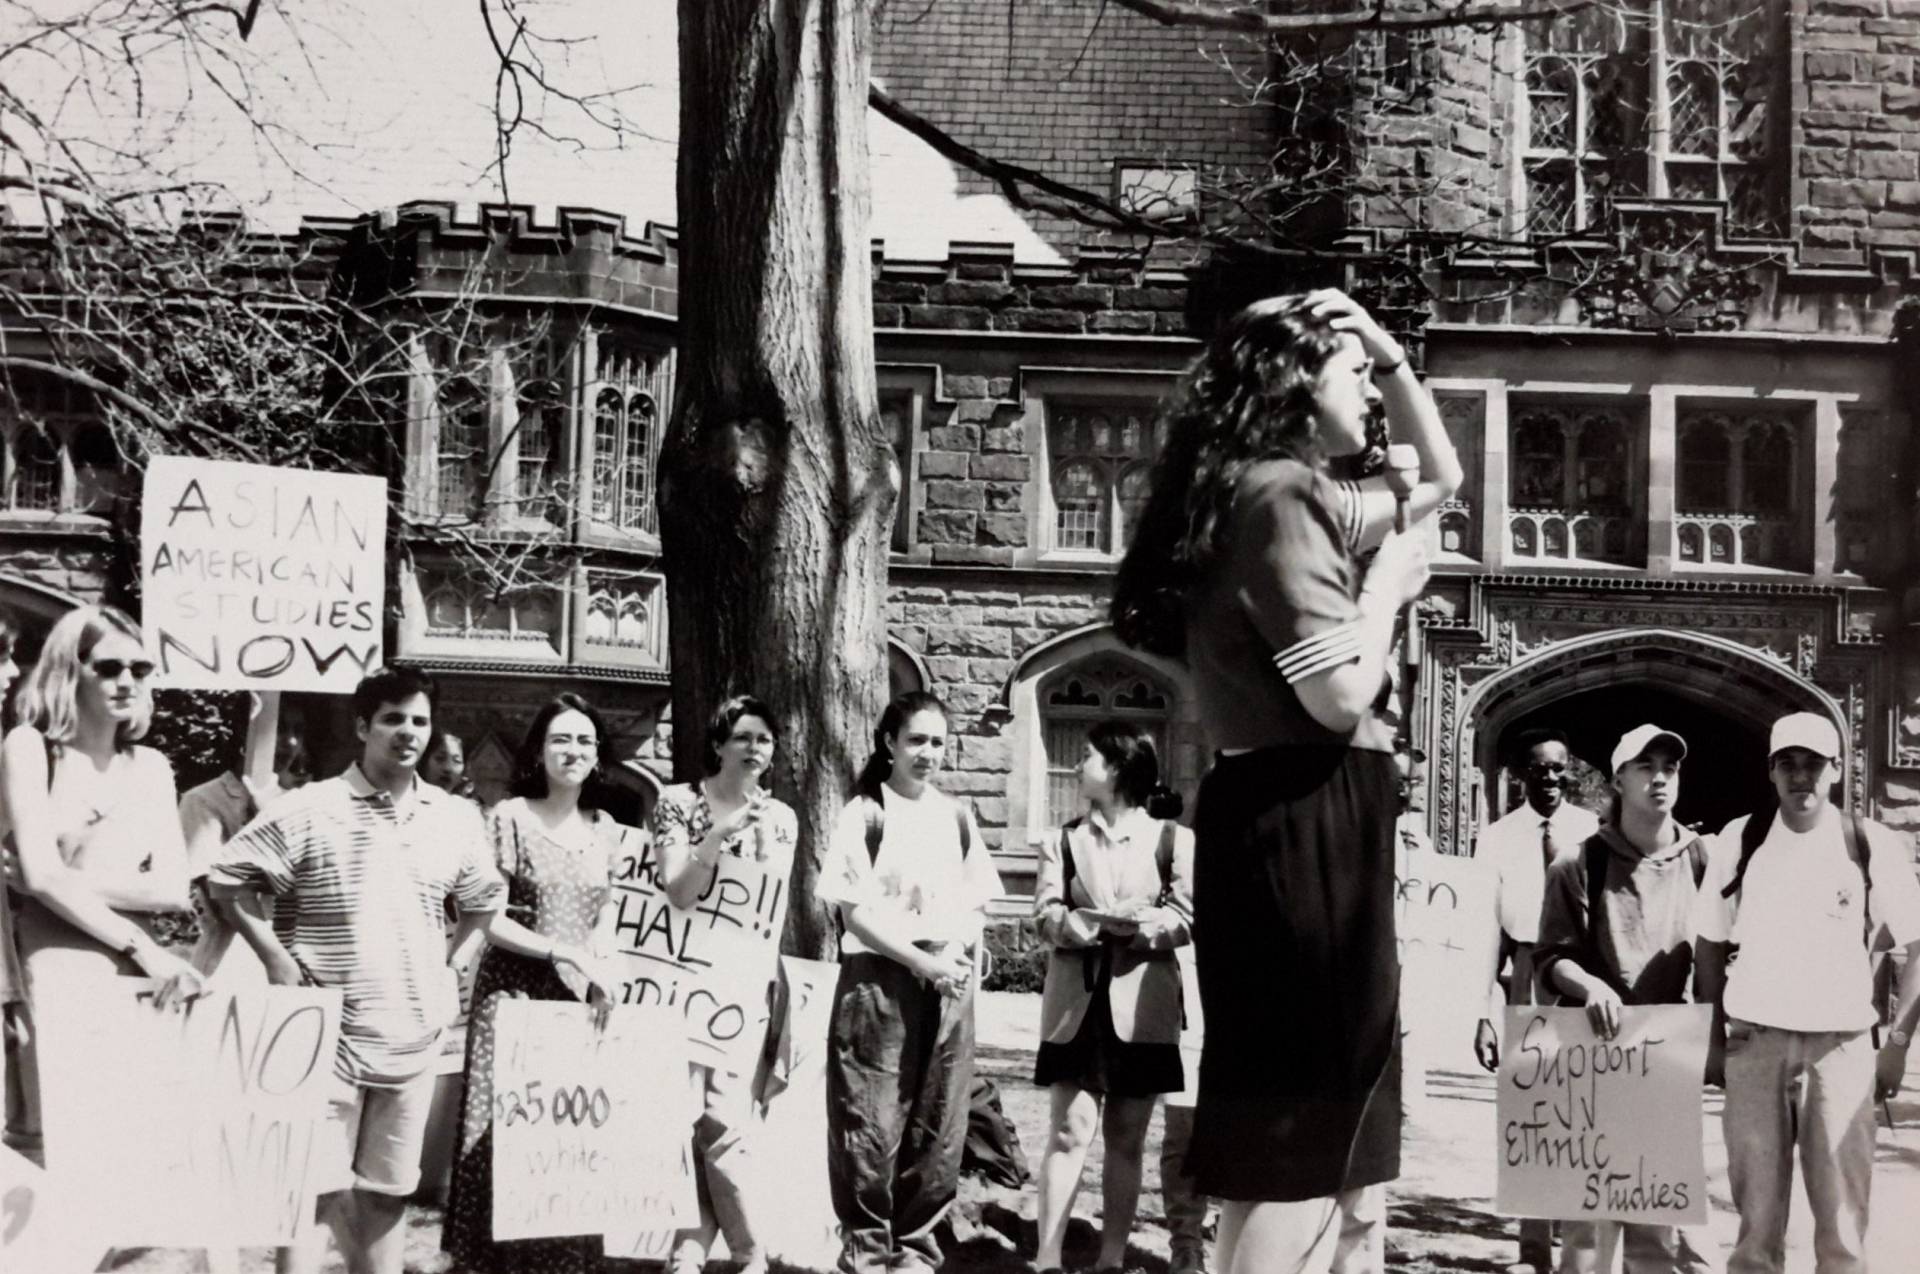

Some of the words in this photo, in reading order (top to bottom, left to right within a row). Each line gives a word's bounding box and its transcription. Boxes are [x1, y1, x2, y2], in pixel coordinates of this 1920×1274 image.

[168, 478, 368, 551] ASIAN
[152, 541, 354, 594] AMERICAN
[174, 591, 374, 632] STUDIES
[159, 627, 378, 678] NOW
[218, 994, 325, 1096] NO
[1512, 1015, 1665, 1130] Support
[1505, 1100, 1610, 1170] Ethnic
[1582, 1155, 1690, 1212] Studies
